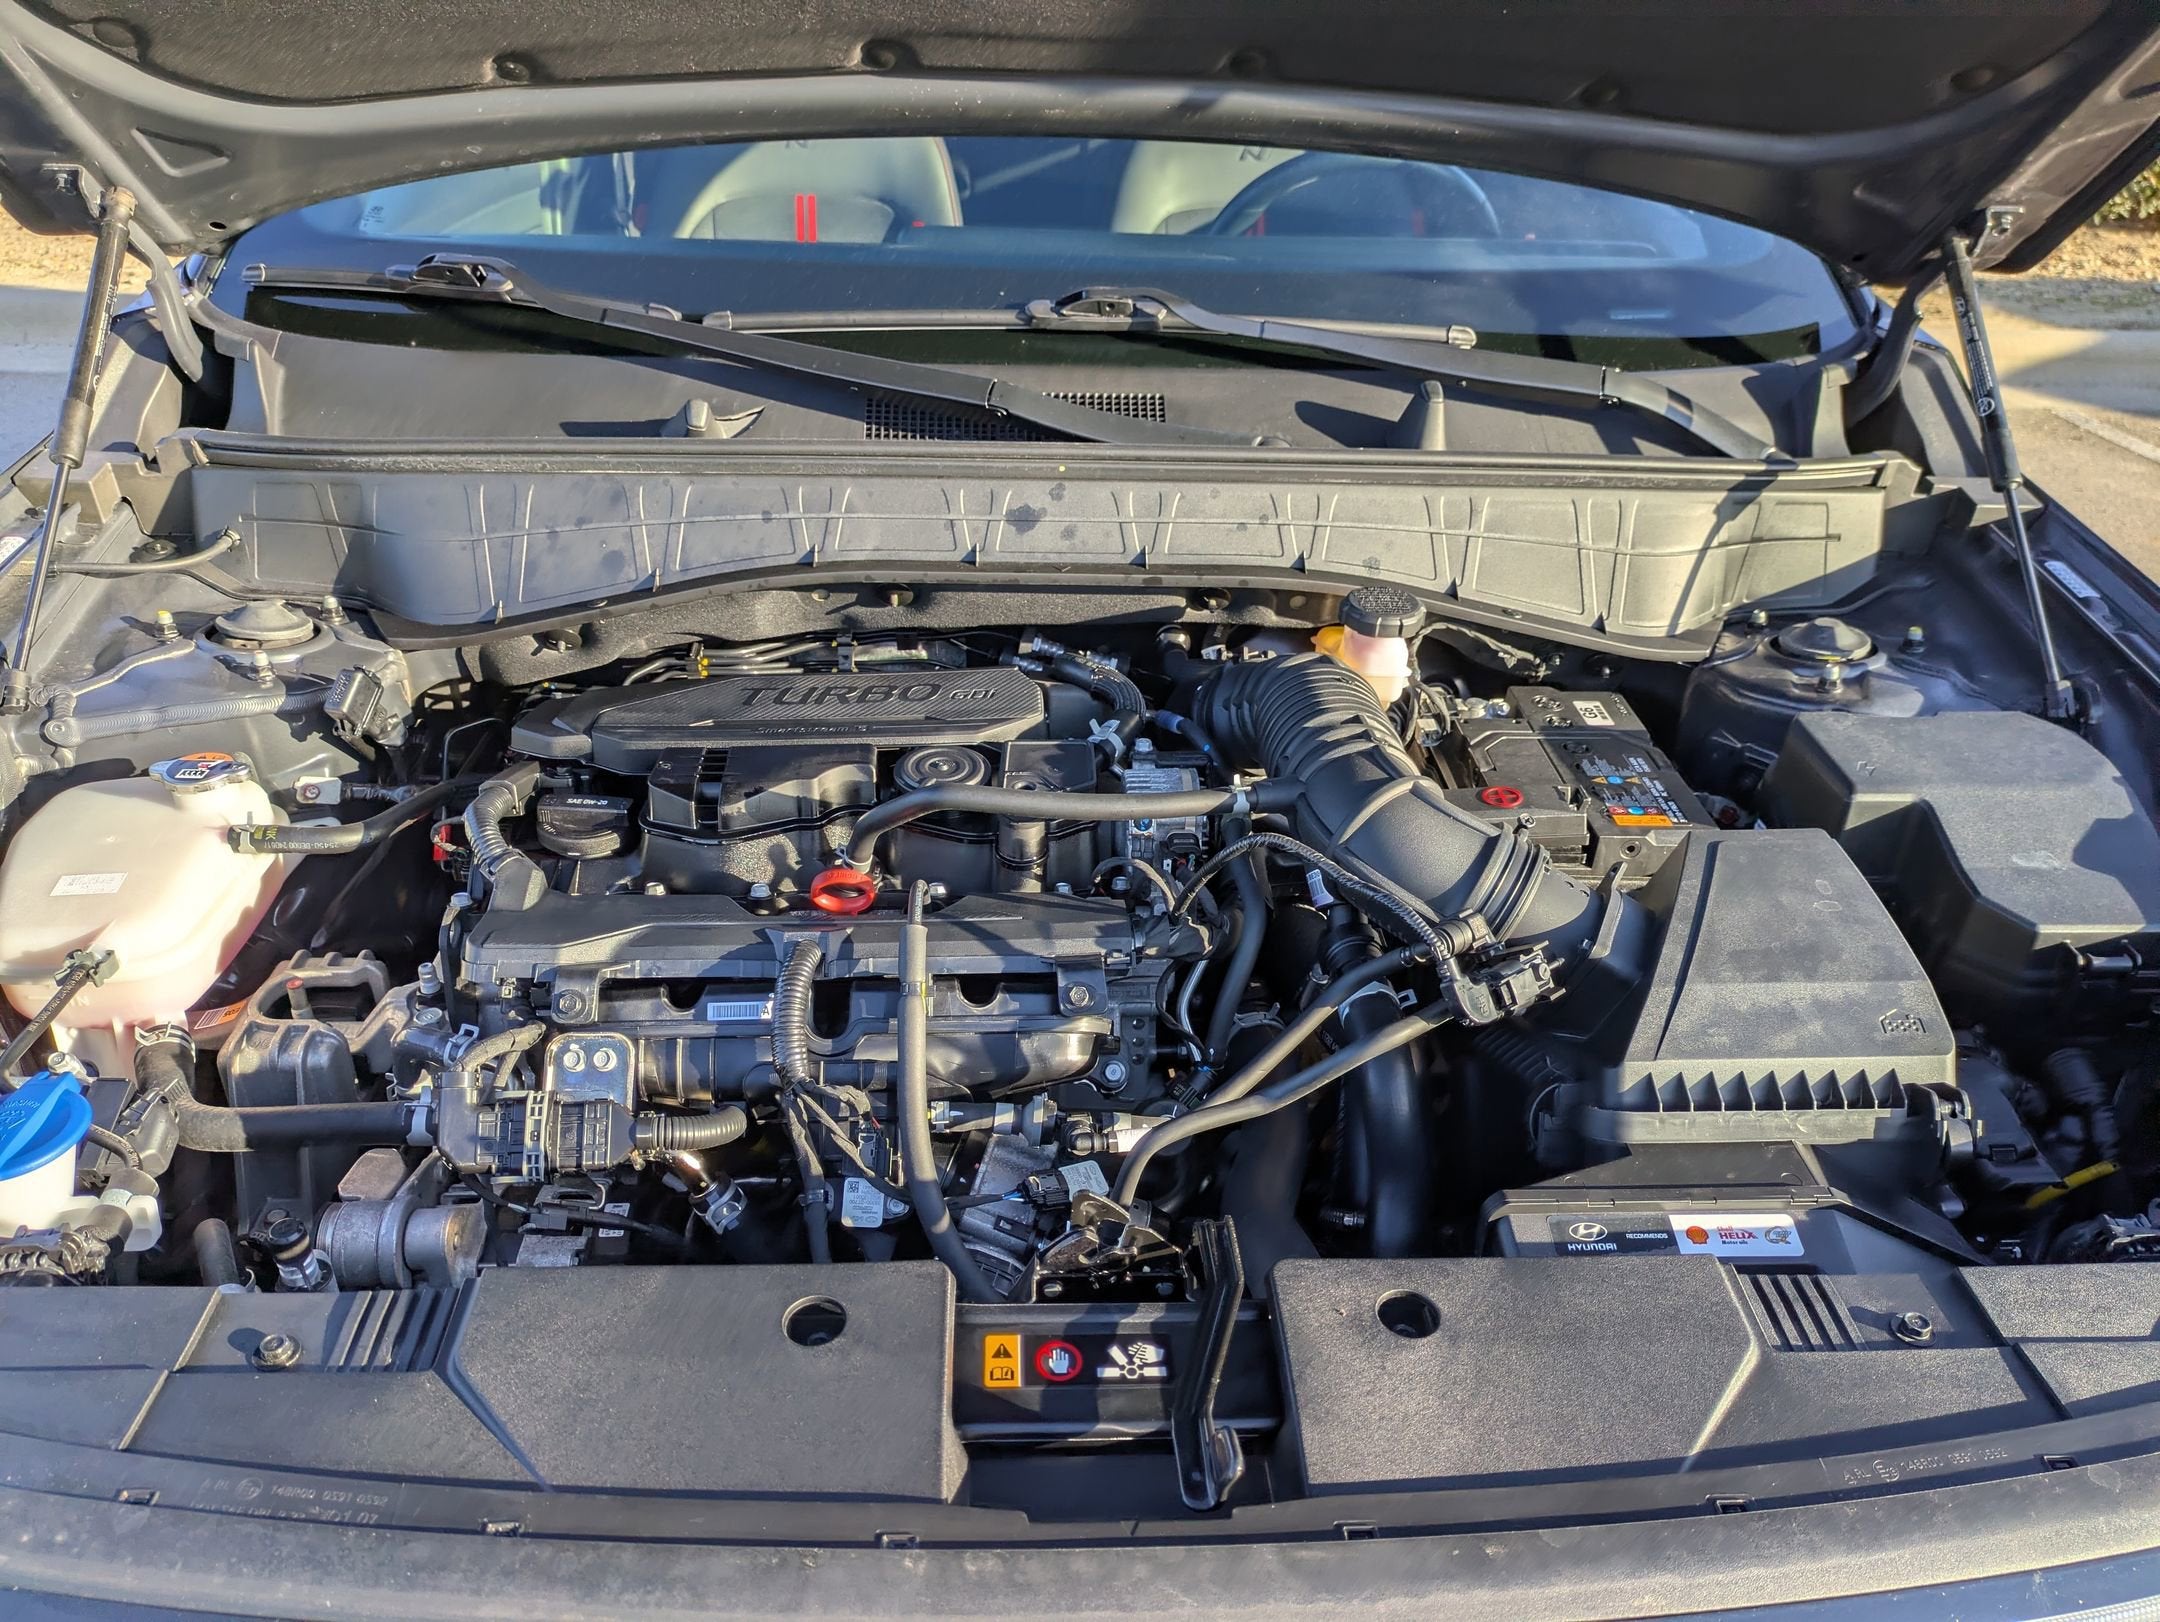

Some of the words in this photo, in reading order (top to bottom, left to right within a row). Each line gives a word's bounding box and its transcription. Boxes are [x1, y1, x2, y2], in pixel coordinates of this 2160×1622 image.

[741, 683, 942, 706] TURBO
[1579, 706, 1599, 720] G6
[754, 726, 849, 734] Smartstream
[1719, 1231, 1758, 1239] HELIX
[1568, 1242, 1618, 1251] HYUNDAI
